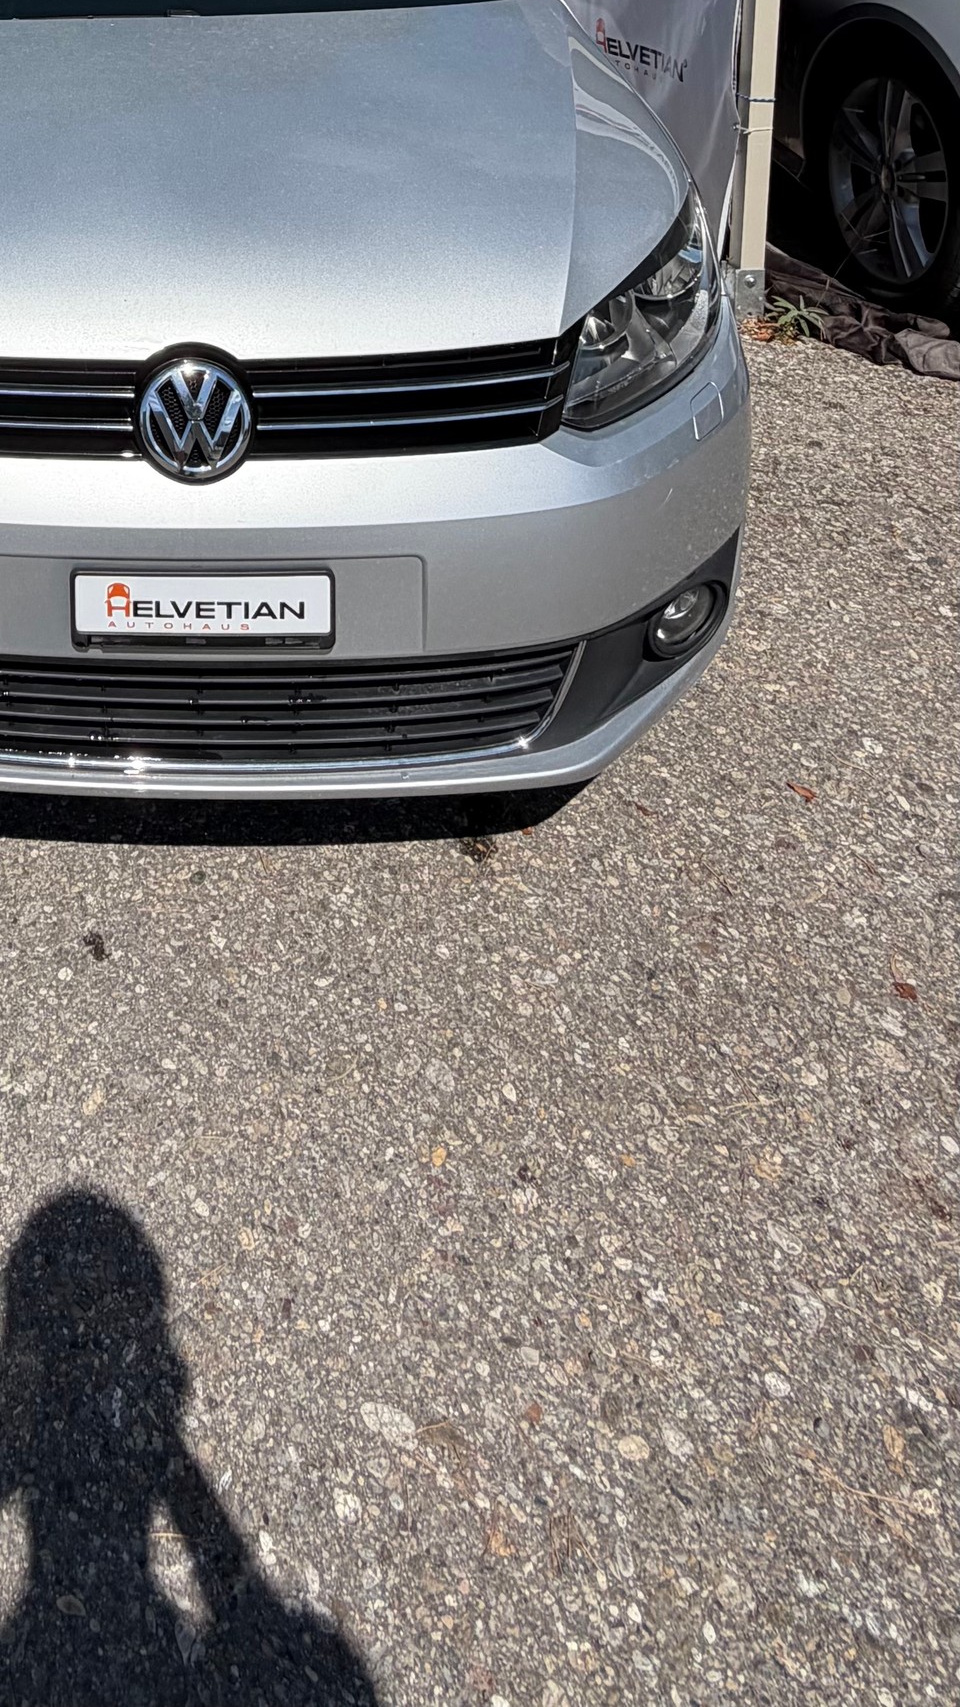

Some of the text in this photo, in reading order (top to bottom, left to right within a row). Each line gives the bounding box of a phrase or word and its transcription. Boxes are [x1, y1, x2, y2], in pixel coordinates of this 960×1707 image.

[143, 360, 251, 475] VW
[105, 583, 305, 619] HELVETIAN
[108, 621, 249, 630] AUTOHAUS
